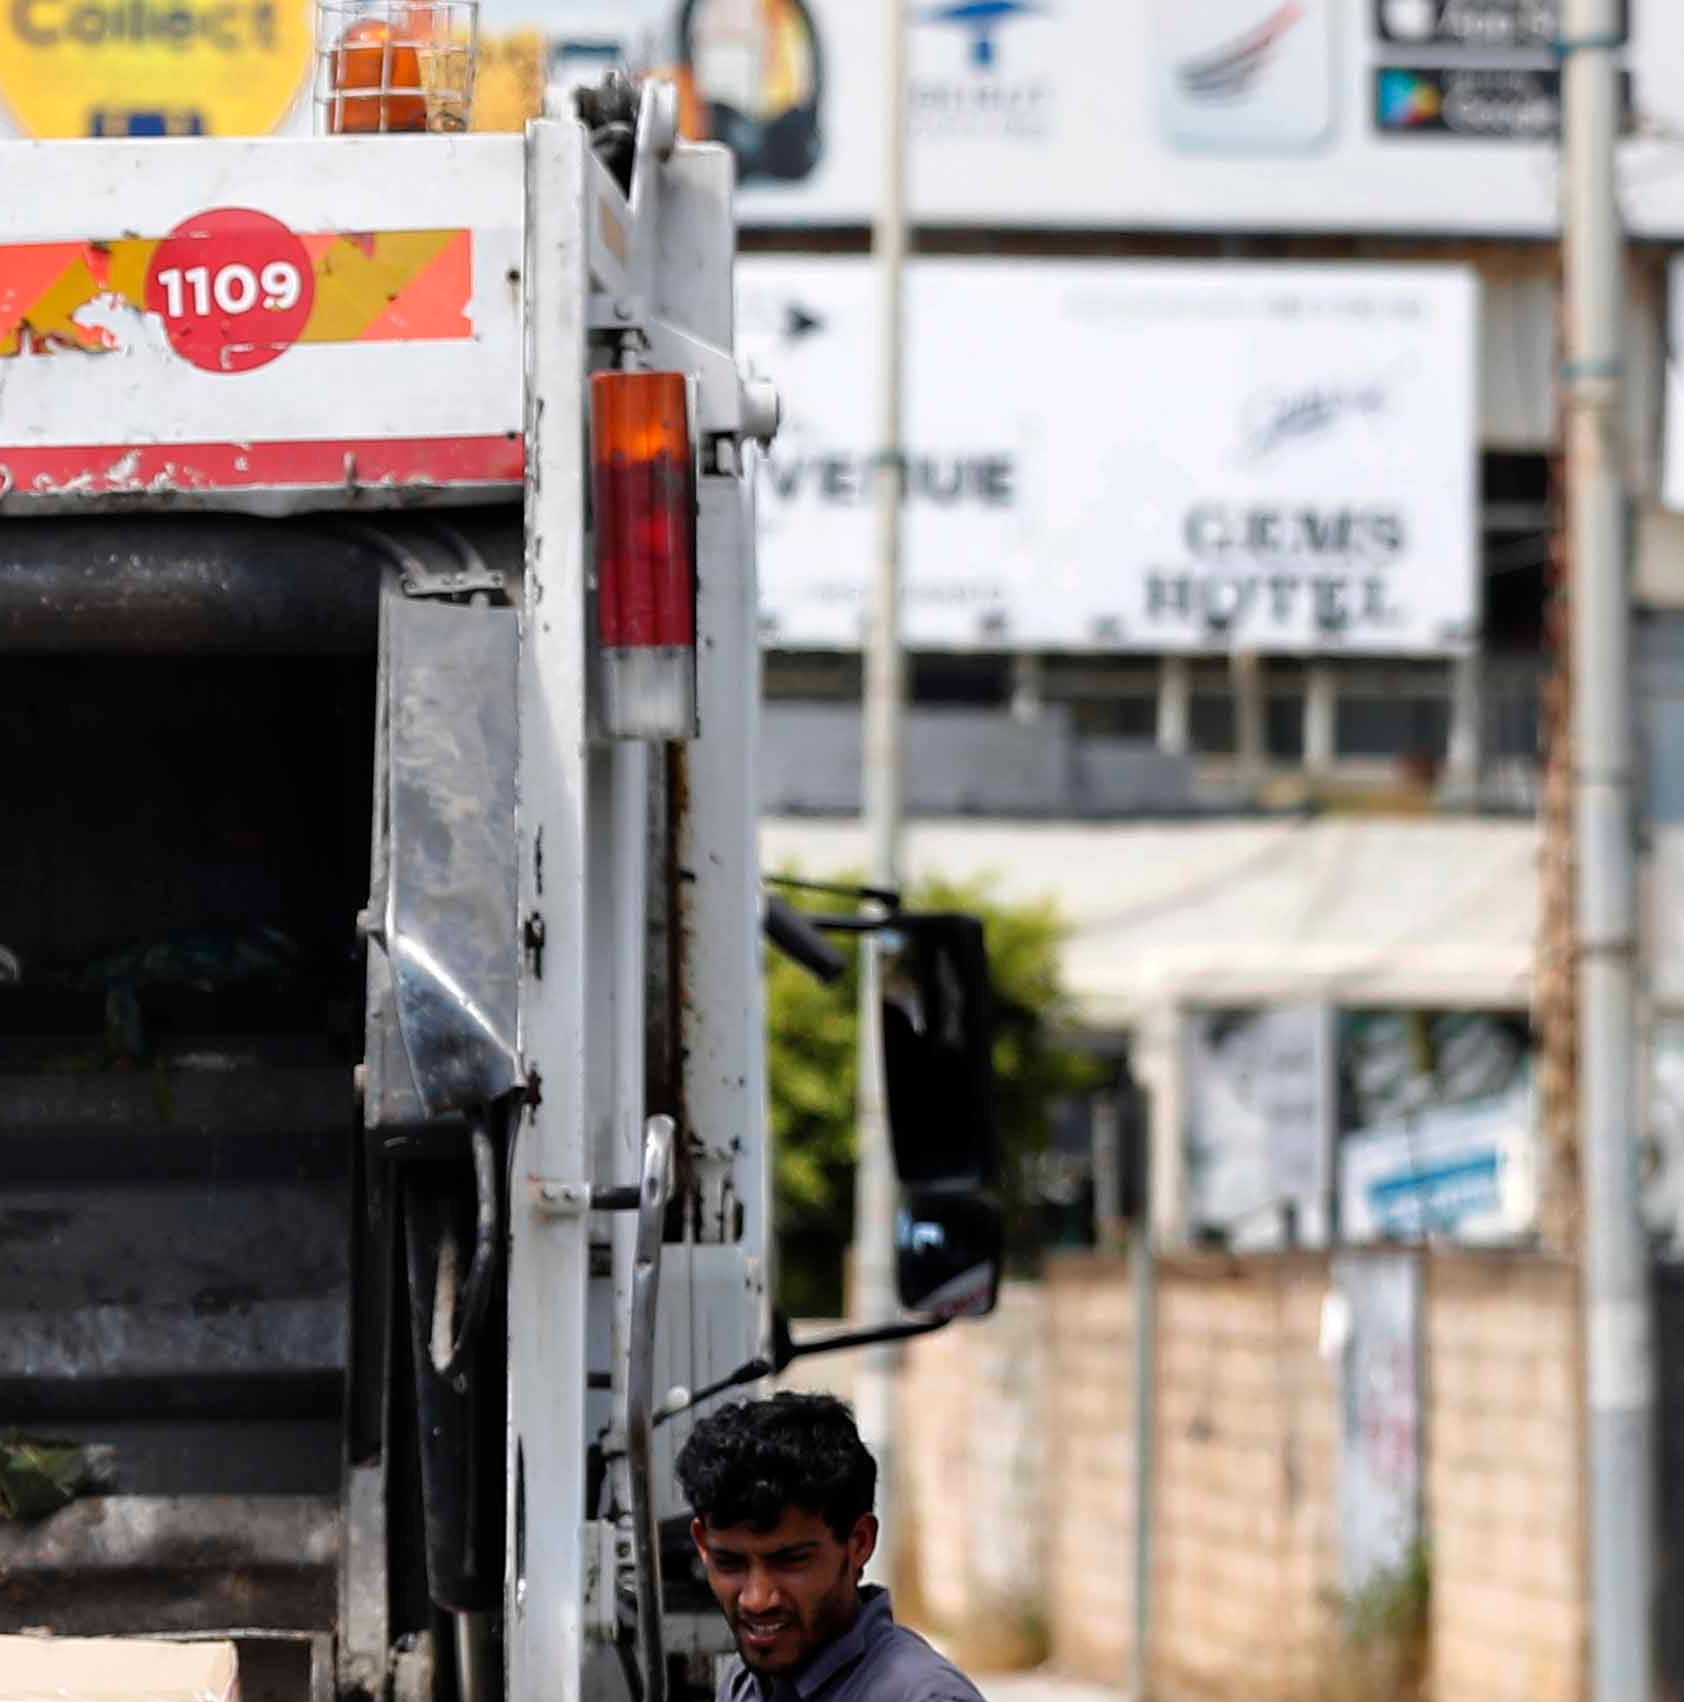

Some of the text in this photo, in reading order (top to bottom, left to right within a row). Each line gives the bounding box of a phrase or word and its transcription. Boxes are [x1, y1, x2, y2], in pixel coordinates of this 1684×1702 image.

[9, 0, 280, 51] Collect
[158, 260, 302, 318] 1109
[1183, 505, 1408, 562] GEMS
[1144, 568, 1402, 627] HOTEL
